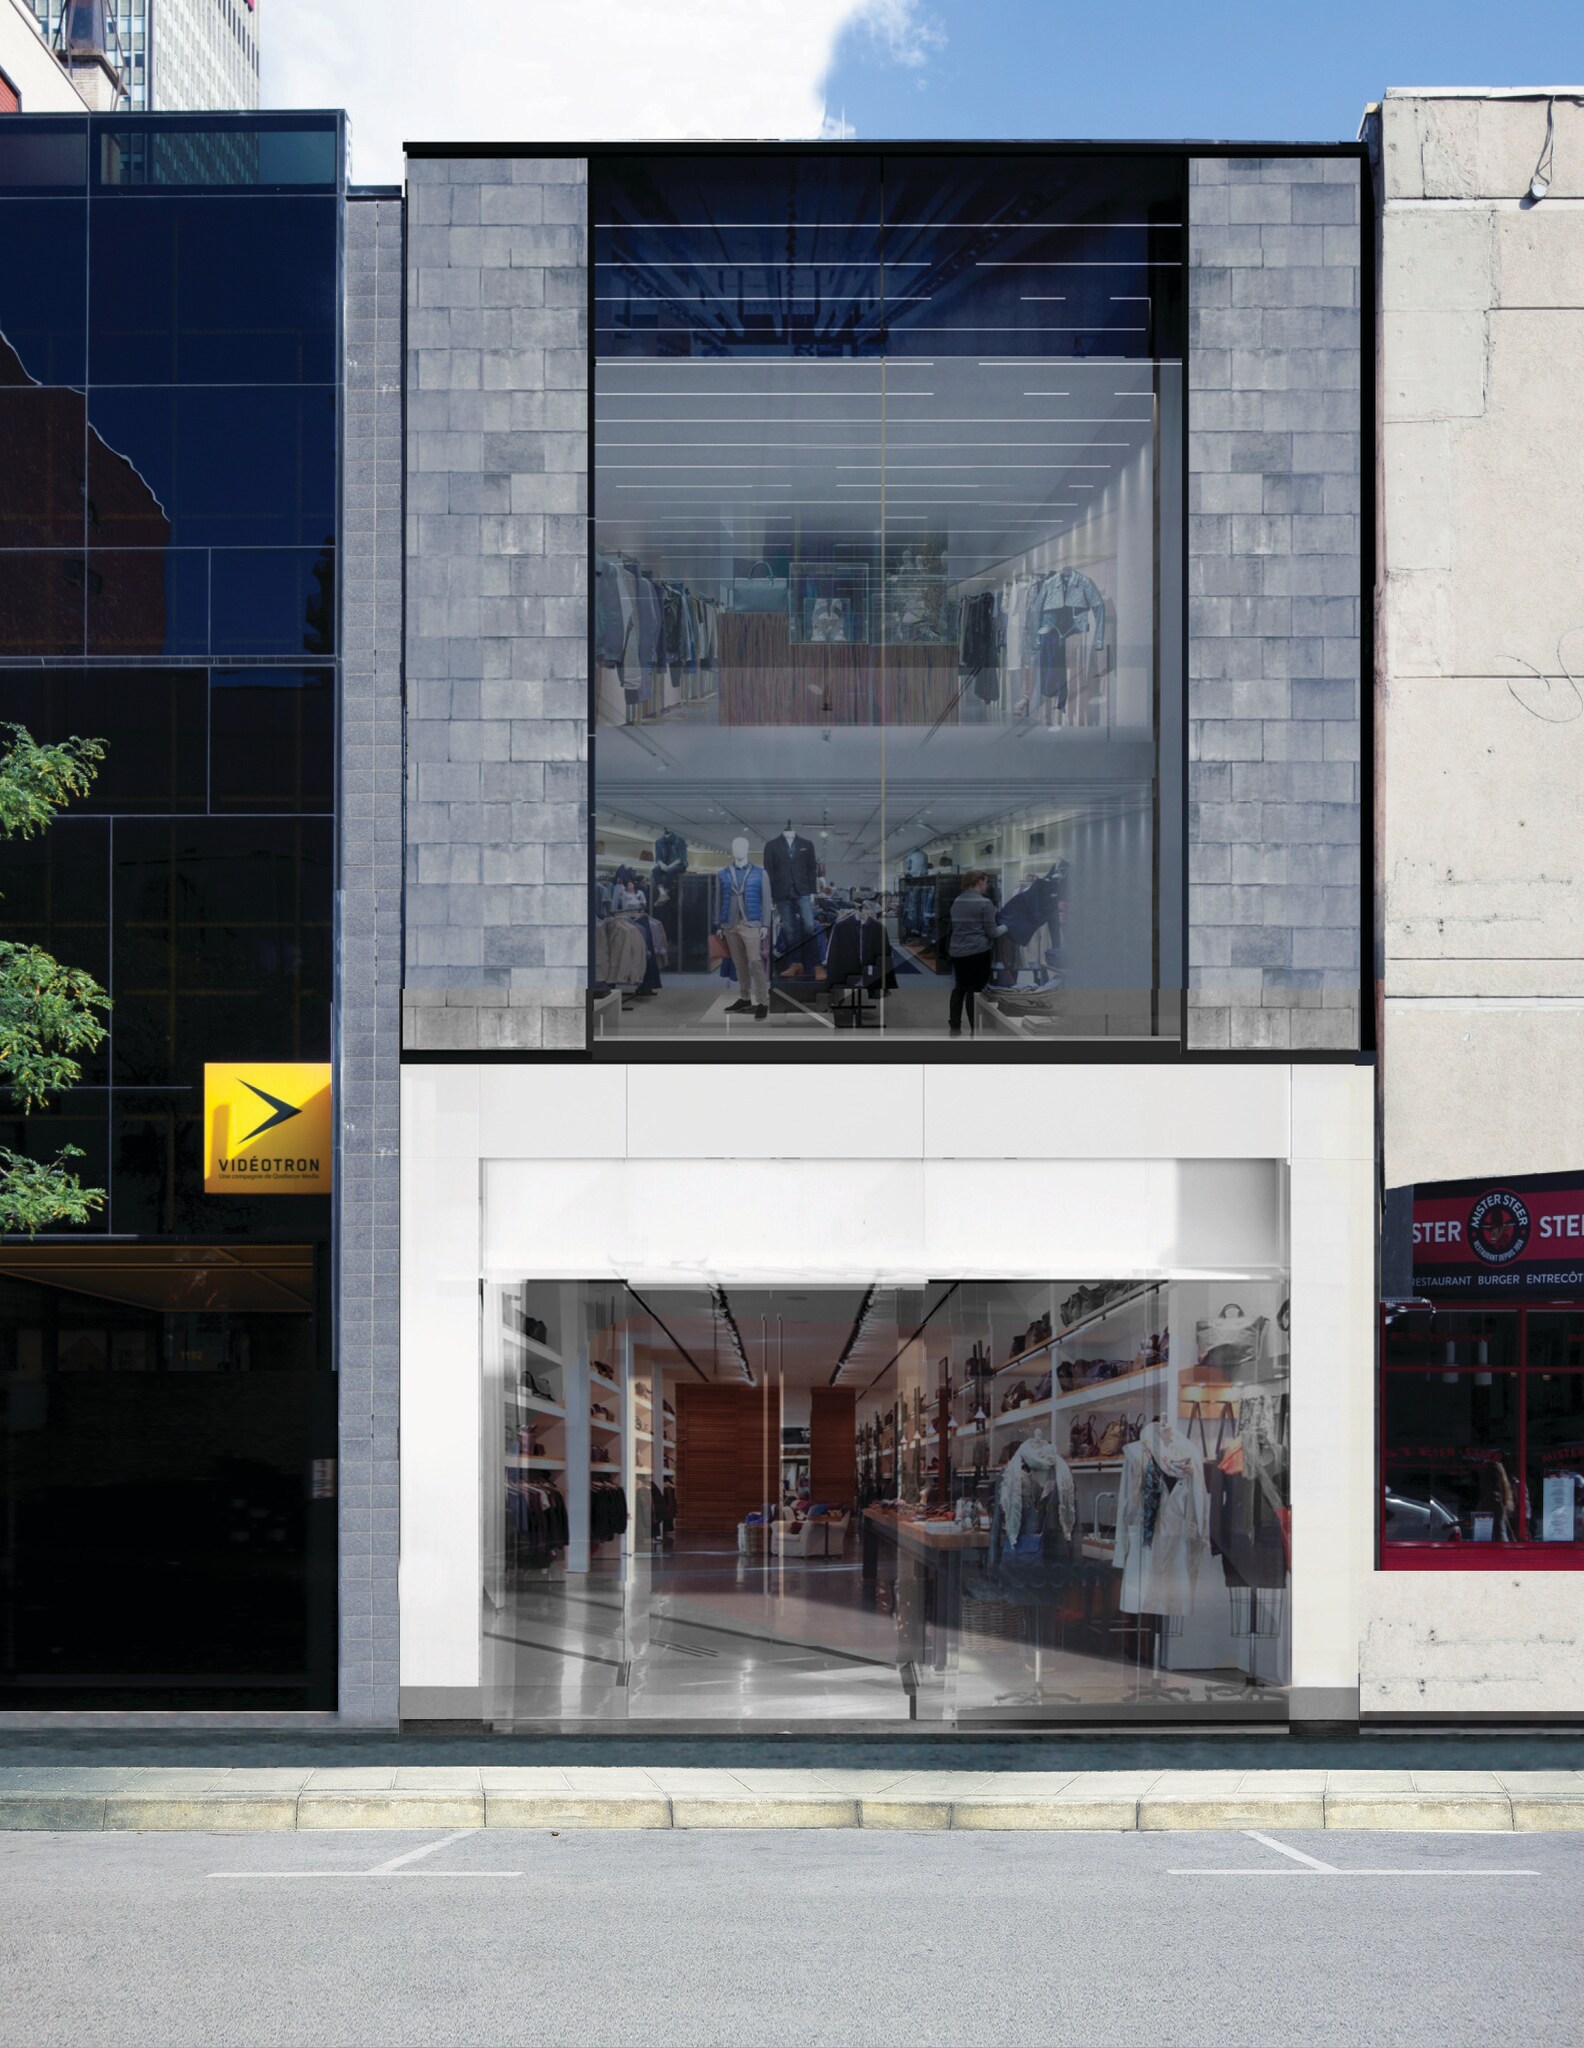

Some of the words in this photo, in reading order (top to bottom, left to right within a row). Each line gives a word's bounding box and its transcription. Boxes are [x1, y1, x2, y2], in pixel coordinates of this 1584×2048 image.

[218, 1156, 320, 1172] VIDÉOTRON
[1471, 1194, 1501, 1229] MISTER
[1502, 1195, 1528, 1226] STEER
[1540, 1214, 1584, 1238] STE
[1478, 1274, 1520, 1286] BURGER
